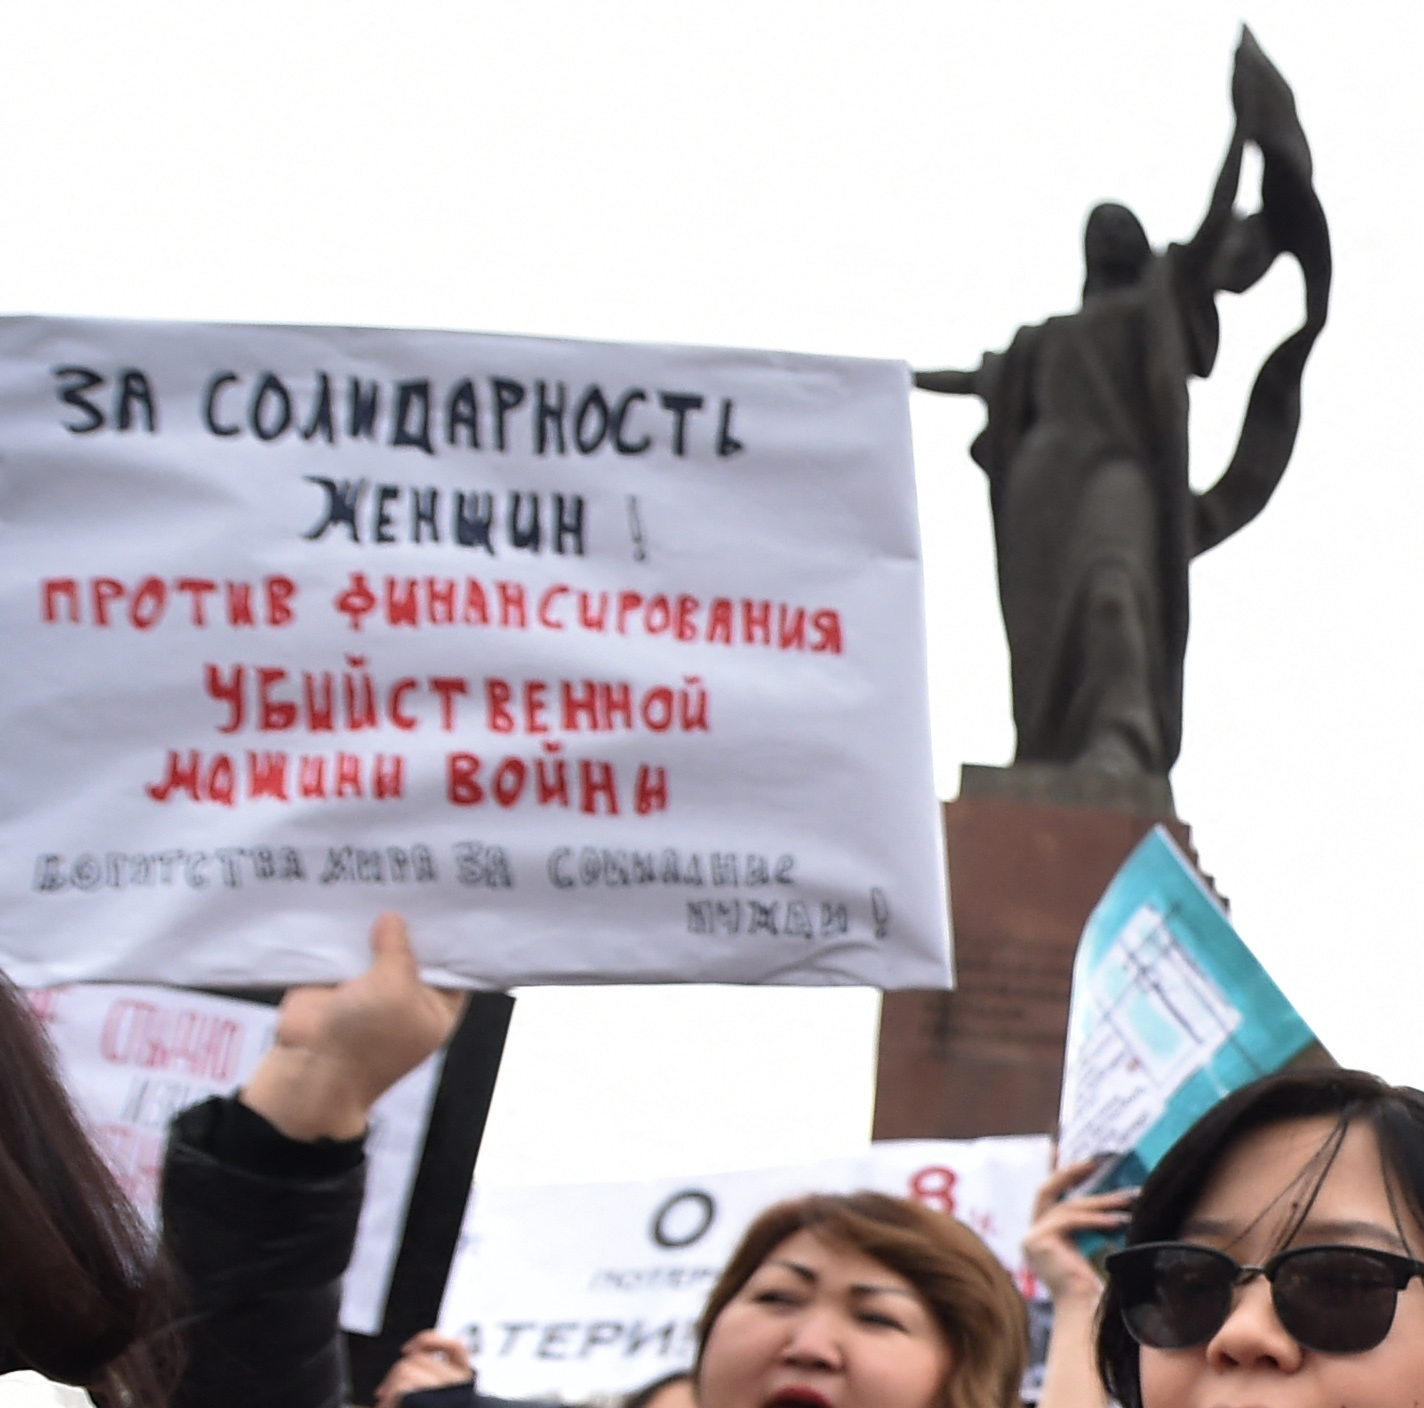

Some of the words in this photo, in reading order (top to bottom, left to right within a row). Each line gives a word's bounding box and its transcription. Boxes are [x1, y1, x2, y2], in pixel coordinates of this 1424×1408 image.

[55, 366, 158, 436] ЗА
[203, 371, 744, 457] СОЛИДАРНОСТЬ
[300, 476, 586, 556] ЖЕНЩИН
[40, 573, 298, 631] ПРОТИВ
[333, 570, 846, 655] ФИНАНСИРОВАНИЯ
[204, 654, 710, 734] УБИЙСТВЕННОЙ
[444, 740, 669, 815] ВОЙНЫ
[452, 840, 513, 889] ЗА
